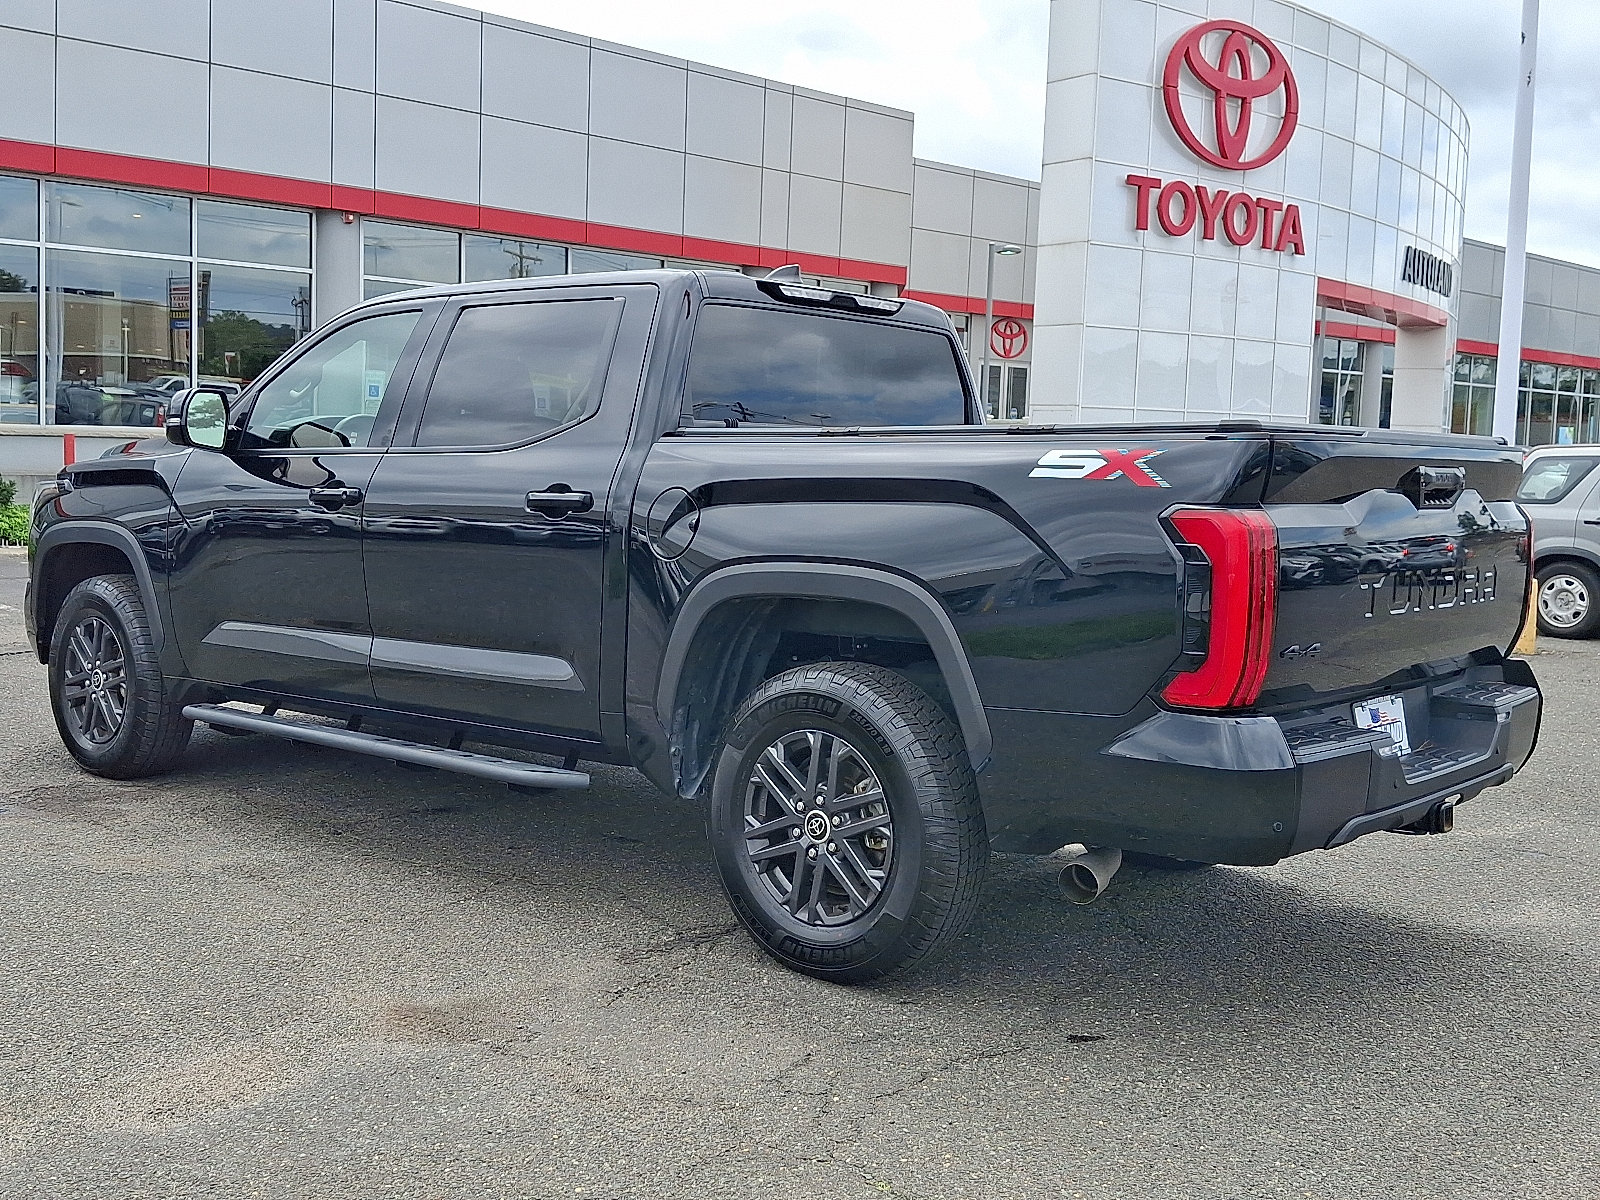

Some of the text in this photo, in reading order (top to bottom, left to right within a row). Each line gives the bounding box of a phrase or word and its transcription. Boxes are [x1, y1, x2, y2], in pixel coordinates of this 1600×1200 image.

[1126, 174, 1305, 255] TOYOTA
[1028, 448, 1173, 488] SX
[1357, 563, 1498, 618] TUNDRA
[757, 694, 838, 722] MICHELIN
